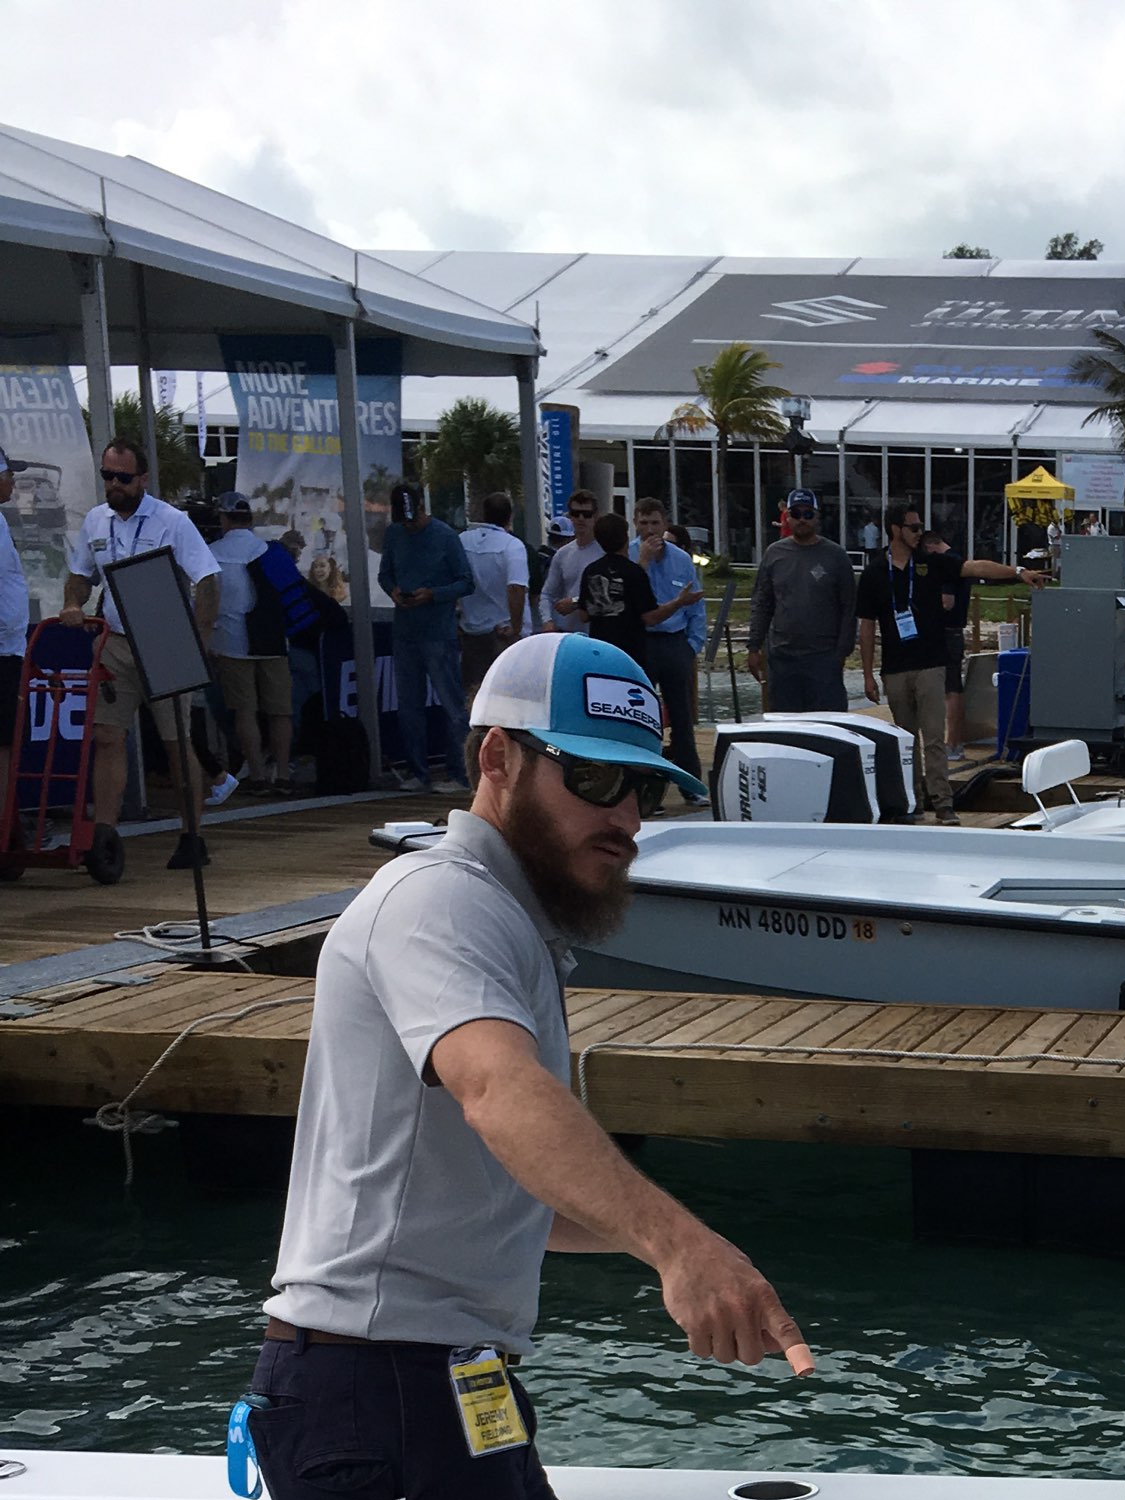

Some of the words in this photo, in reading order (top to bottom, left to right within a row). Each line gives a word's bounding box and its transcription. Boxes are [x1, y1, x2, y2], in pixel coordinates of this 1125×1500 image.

[235, 361, 309, 395] MORE
[898, 375, 1043, 387] MARINE
[248, 395, 398, 436] ADVENTRES
[590, 702, 662, 731] SEAKEEPE
[718, 906, 752, 931] MN
[758, 908, 810, 937] 4800
[817, 915, 847, 940] DD
[854, 920, 874, 940] 18
